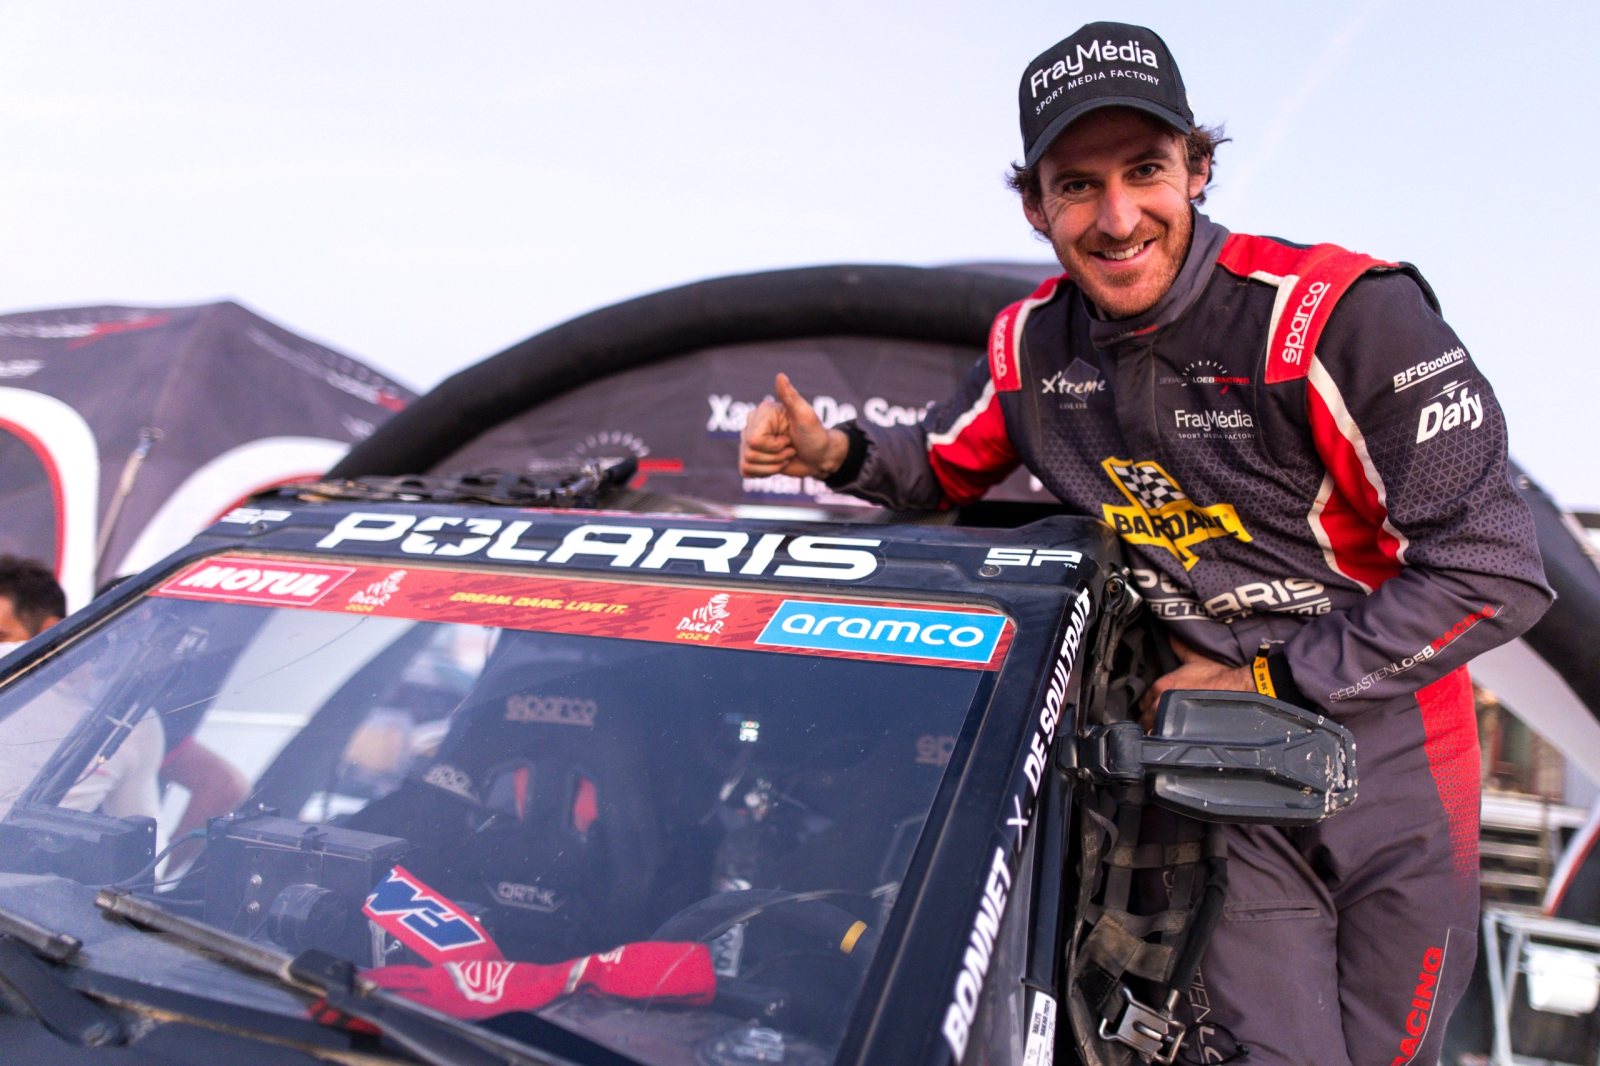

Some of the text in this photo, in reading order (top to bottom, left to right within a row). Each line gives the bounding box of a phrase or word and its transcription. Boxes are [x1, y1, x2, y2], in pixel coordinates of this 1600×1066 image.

[1030, 39, 1159, 98] FrayMédia
[1035, 69, 1160, 115] SPORT MEDIA FACTORY
[1282, 281, 1331, 365] sparco
[1392, 346, 1466, 389] BFGoodrich
[1174, 409, 1254, 432] FrayMédia
[1416, 385, 1485, 444] Dafy
[316, 511, 882, 581] POLARIS
[179, 564, 334, 598] MOTUL
[565, 601, 607, 613] LIVE
[676, 631, 711, 641] 2024
[781, 612, 984, 648] aramco
[942, 846, 1012, 1064] BONNET
[1023, 732, 1047, 796] DE
[1039, 587, 1090, 746] SOULTRAIT
